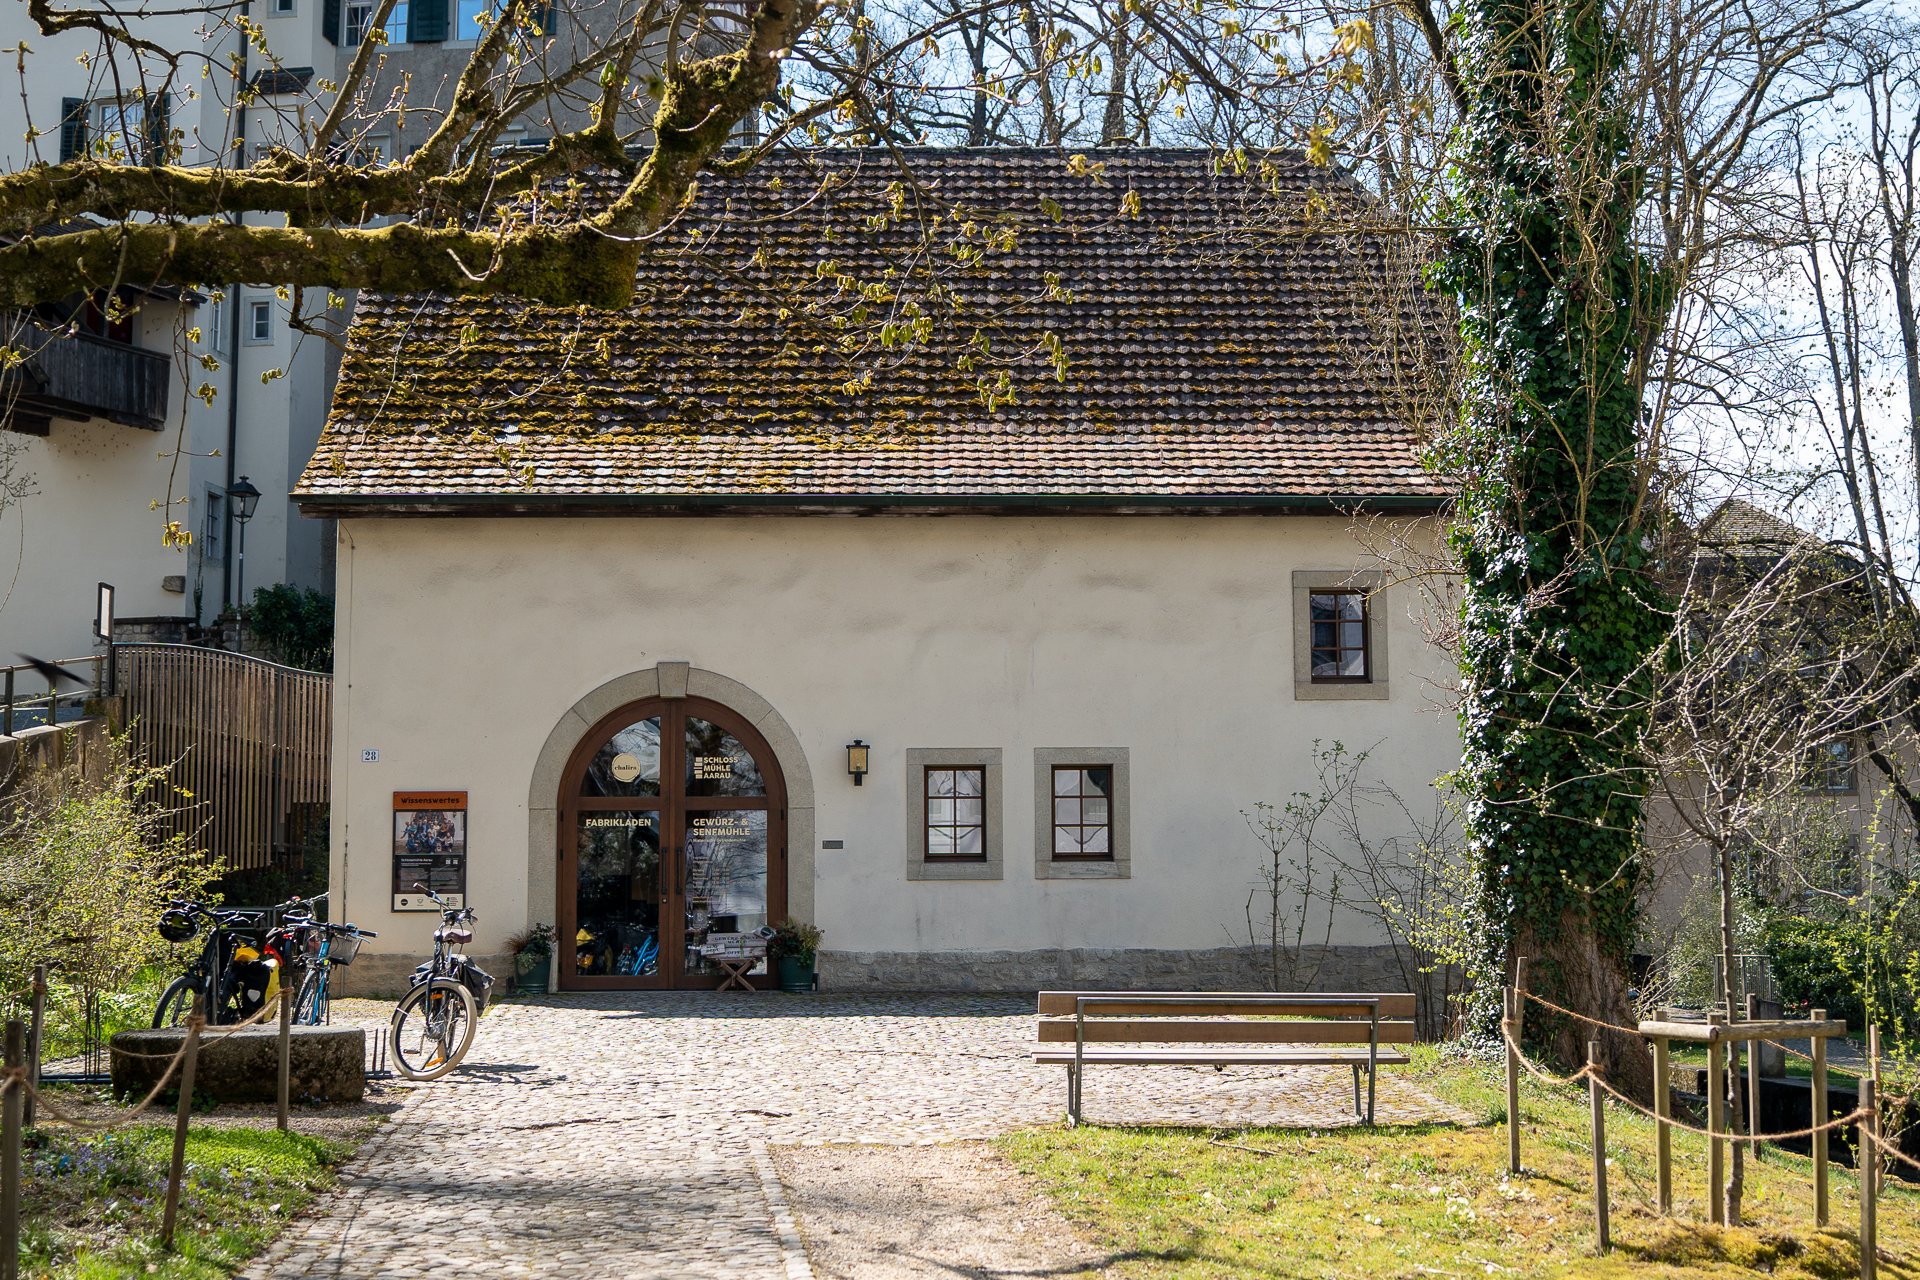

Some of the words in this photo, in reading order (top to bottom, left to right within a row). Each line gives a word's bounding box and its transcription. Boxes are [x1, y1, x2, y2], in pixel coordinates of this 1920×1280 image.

[364, 751, 376, 760] 28
[703, 756, 739, 764] SCHLOSS
[703, 764, 731, 772] MÜHLE
[400, 796, 460, 804] Wissenswertes
[585, 818, 652, 827] FABRIKLADEN
[693, 816, 738, 826] GEWÜRZ-
[741, 818, 749, 826] &
[693, 826, 751, 836] SENFMÜHLE
